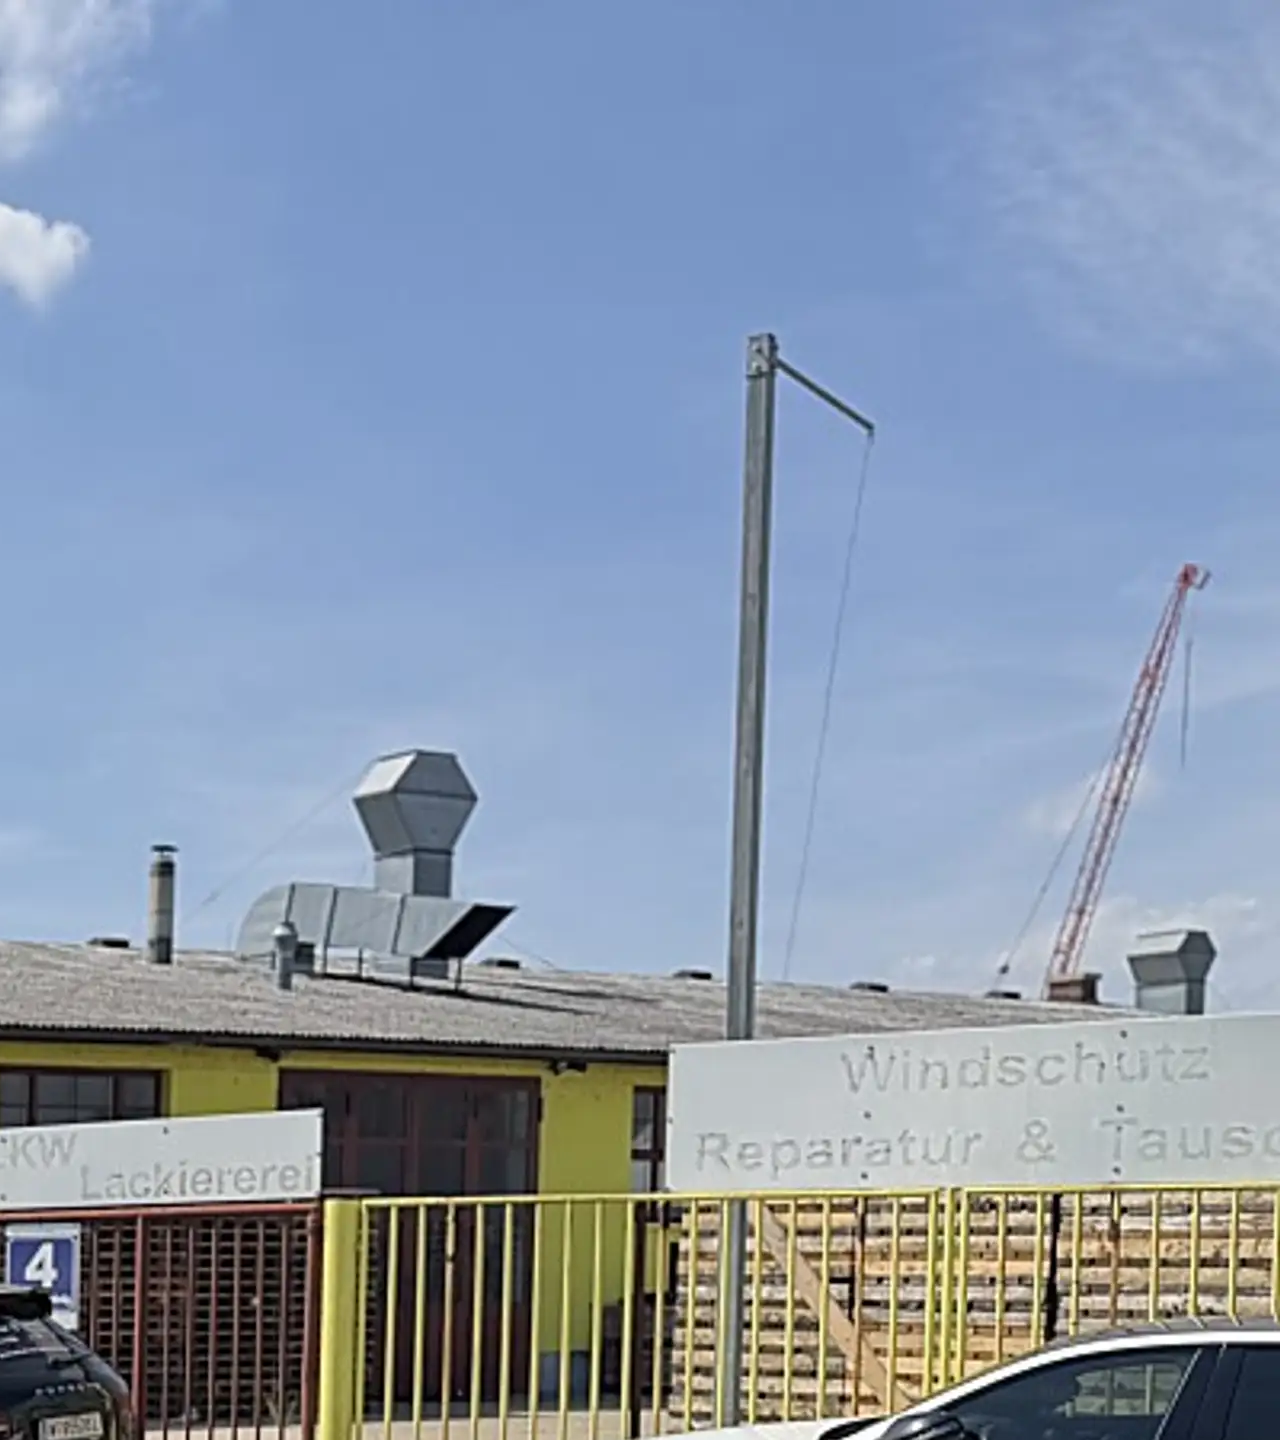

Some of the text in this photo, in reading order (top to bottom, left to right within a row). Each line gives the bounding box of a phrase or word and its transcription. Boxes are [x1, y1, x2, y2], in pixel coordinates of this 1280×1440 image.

[840, 1042, 1210, 1094] Windschutz
[695, 1127, 983, 1180] Reparatur
[1017, 1117, 1059, 1166] &
[79, 1155, 315, 1202] Lackiererei
[24, 1241, 60, 1288] 4
